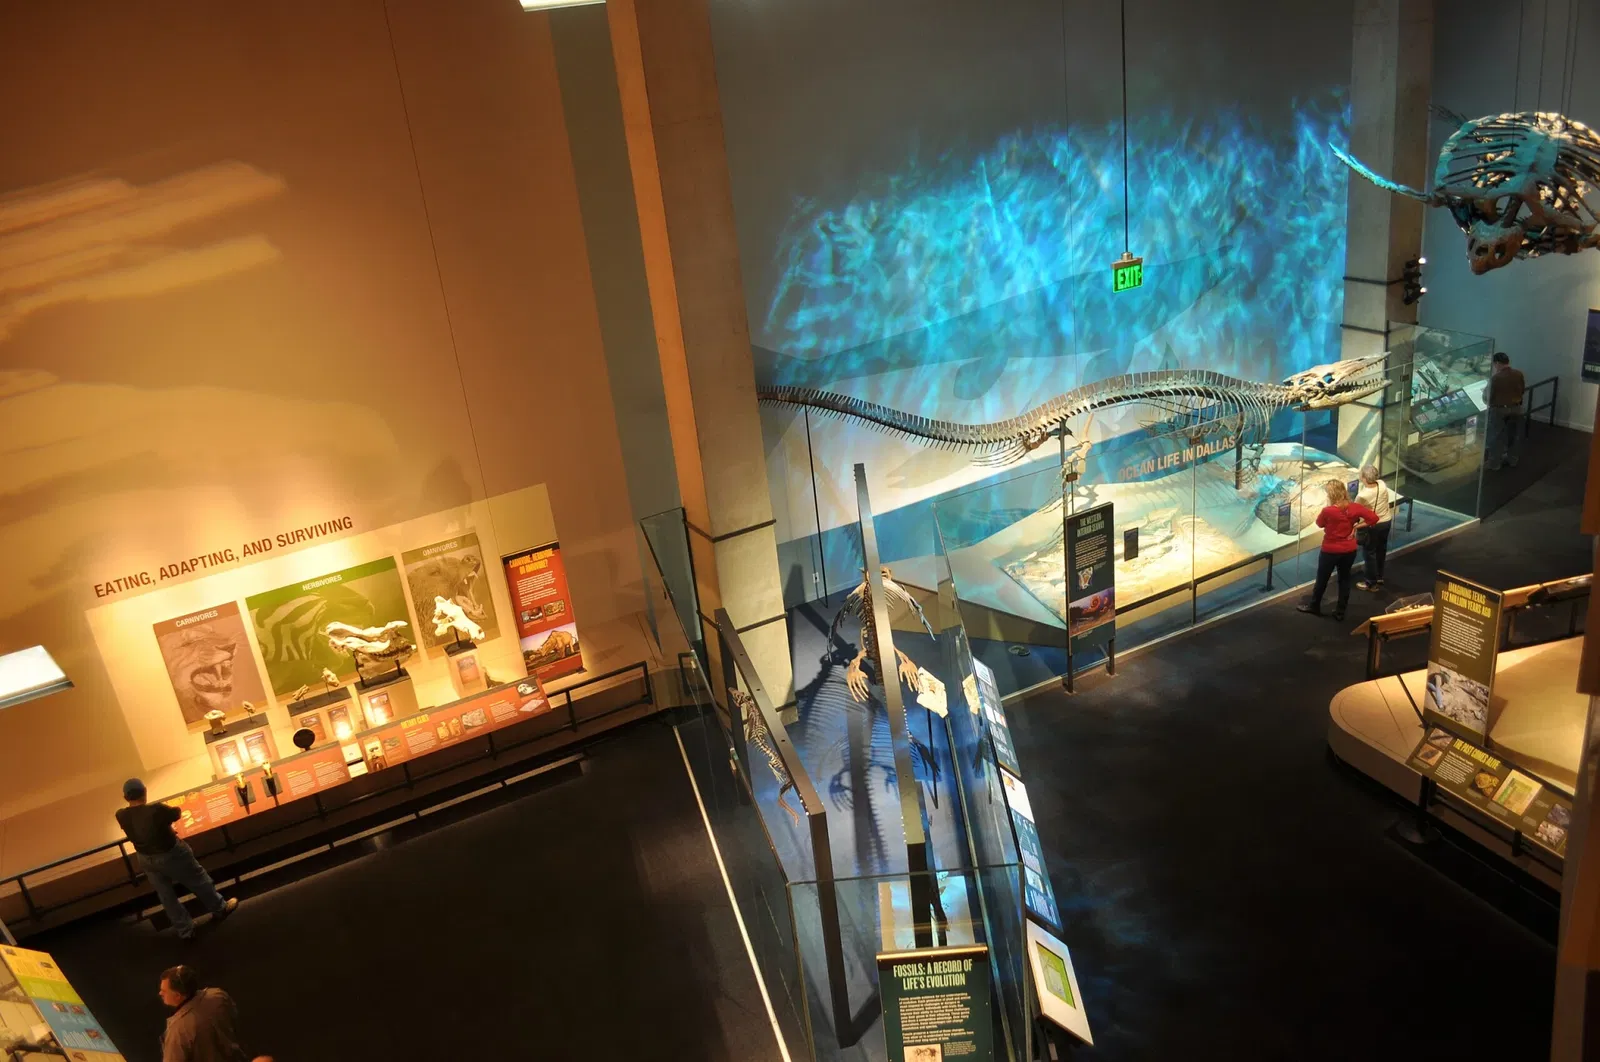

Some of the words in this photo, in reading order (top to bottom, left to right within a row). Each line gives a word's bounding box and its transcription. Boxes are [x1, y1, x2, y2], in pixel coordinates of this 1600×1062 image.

[1117, 265, 1140, 290] EXIT
[1157, 452, 1180, 470] LIFE
[1182, 448, 1195, 462] IN
[1196, 436, 1236, 458] DALLAS
[94, 572, 157, 598] EATING,
[160, 549, 240, 580] ADAPTING,
[243, 538, 273, 557] AND
[276, 516, 353, 547] SURVIVING
[422, 541, 458, 556] OMNIVORES
[302, 574, 343, 591] HERBIVORES
[1471, 590, 1486, 605] TEXAS
[1467, 600, 1482, 615] YEARS
[175, 609, 219, 627] CARNIVORES
[1460, 742, 1475, 756] PAST
[893, 963, 926, 978] FOSSILS:
[927, 962, 933, 975] A
[933, 959, 962, 974] RECORD
[963, 958, 973, 972] OF
[903, 976, 925, 990] LIFE'S
[926, 973, 966, 988] EVOLUTION
